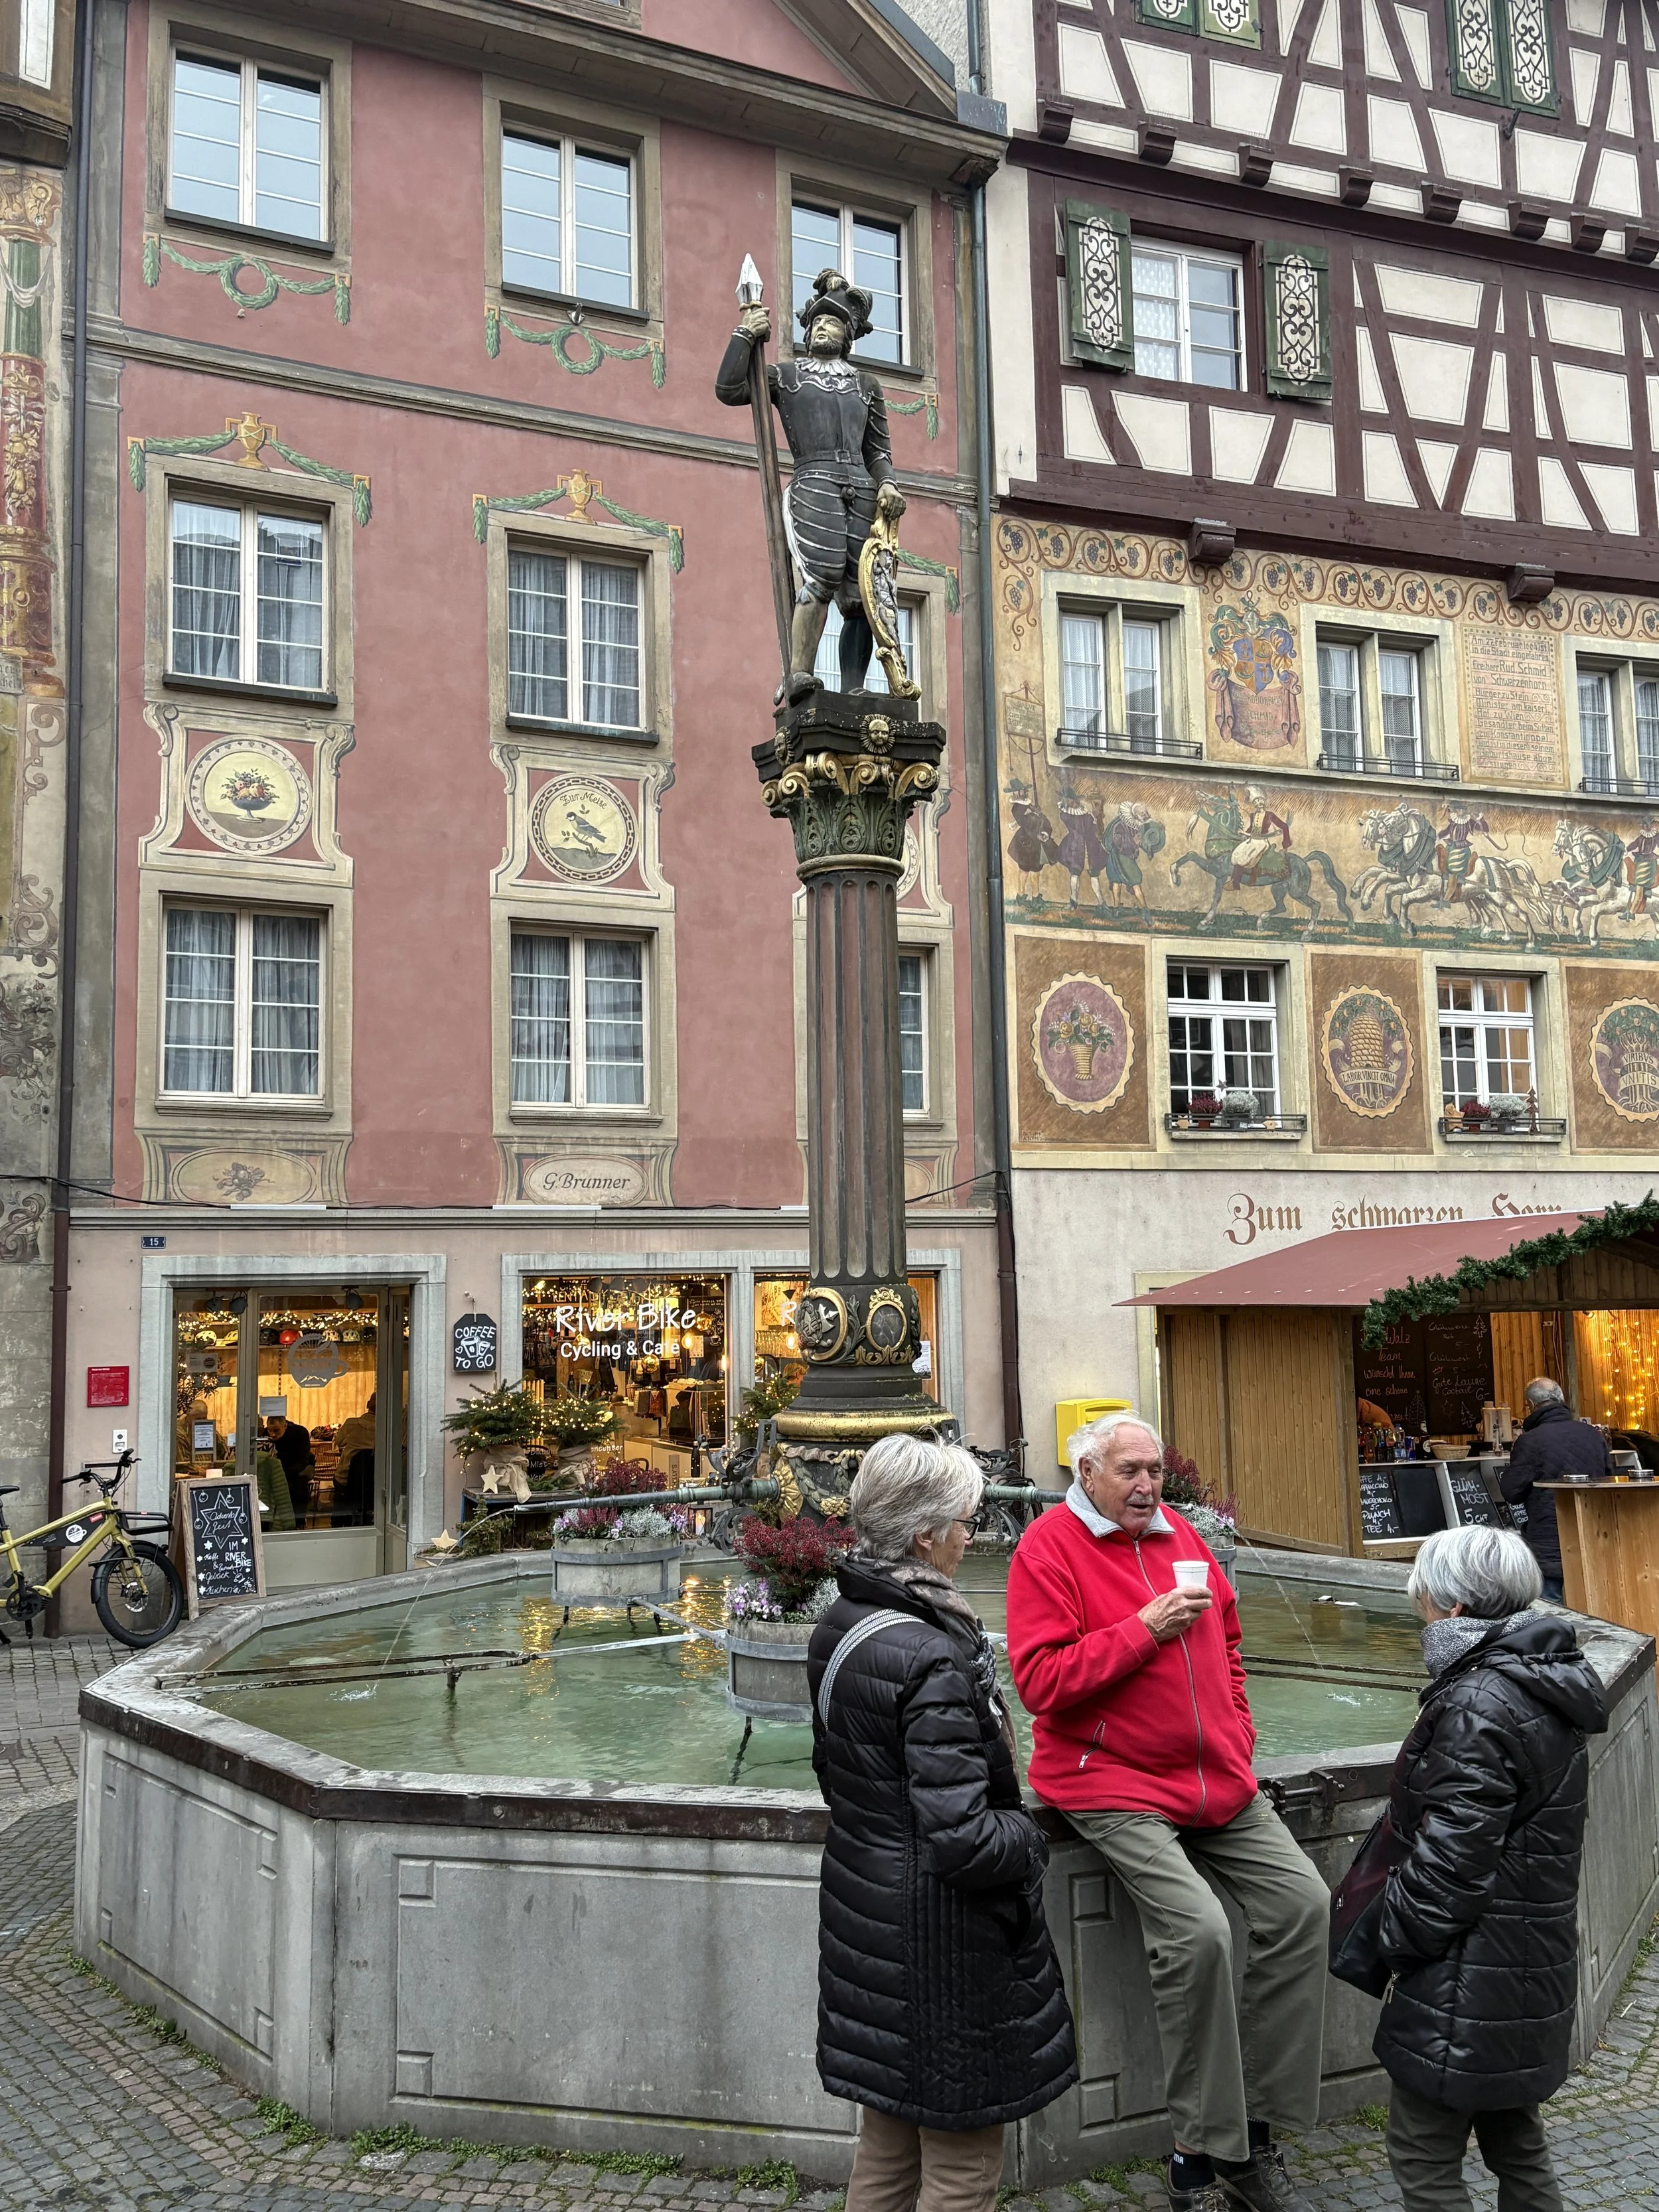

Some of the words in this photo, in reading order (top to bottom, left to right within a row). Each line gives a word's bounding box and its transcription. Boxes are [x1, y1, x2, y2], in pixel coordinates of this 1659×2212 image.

[1471, 634, 1483, 644] Am
[1480, 646, 1490, 655] die
[1491, 647, 1510, 657] Stadt
[1518, 662, 1547, 677] Schmid
[1473, 675, 1486, 684] von
[1490, 674, 1547, 691] Schwarzenhorn
[1510, 691, 1529, 701] Stein
[1476, 698, 1508, 709] Minister
[1477, 708, 1490, 718] Hof
[1504, 710, 1524, 721] Wien
[1477, 718, 1516, 729] Gesandter
[1518, 721, 1534, 731] beim
[1534, 723, 1553, 733] Sultan
[1531, 743, 1554, 753] seinem
[1623, 1052, 1654, 1065] VIRIBVS
[1342, 1071, 1363, 1083] LABOR
[1362, 1070, 1380, 1081] VINCIT
[1380, 1071, 1396, 1085] OMNIA
[1622, 1072, 1657, 1086] VNITIS
[1222, 1193, 1303, 1246] Zum
[149, 1237, 159, 1246] 15
[555, 1305, 630, 1333] River
[638, 1303, 697, 1331] Bike
[455, 1325, 496, 1339] COFFEE
[560, 1341, 621, 1361] Cycling
[626, 1341, 638, 1356] &
[642, 1338, 680, 1355] Café
[1376, 1347, 1402, 1361] Team
[455, 1356, 471, 1369] TO
[476, 1353, 494, 1369] GO
[1459, 1493, 1490, 1505] MOST
[1464, 1508, 1474, 1525] 5
[1364, 1524, 1383, 1534] TEE
[228, 1540, 239, 1551] IM
[224, 1551, 248, 1562] RIVER
[235, 1559, 253, 1568] BIKE
